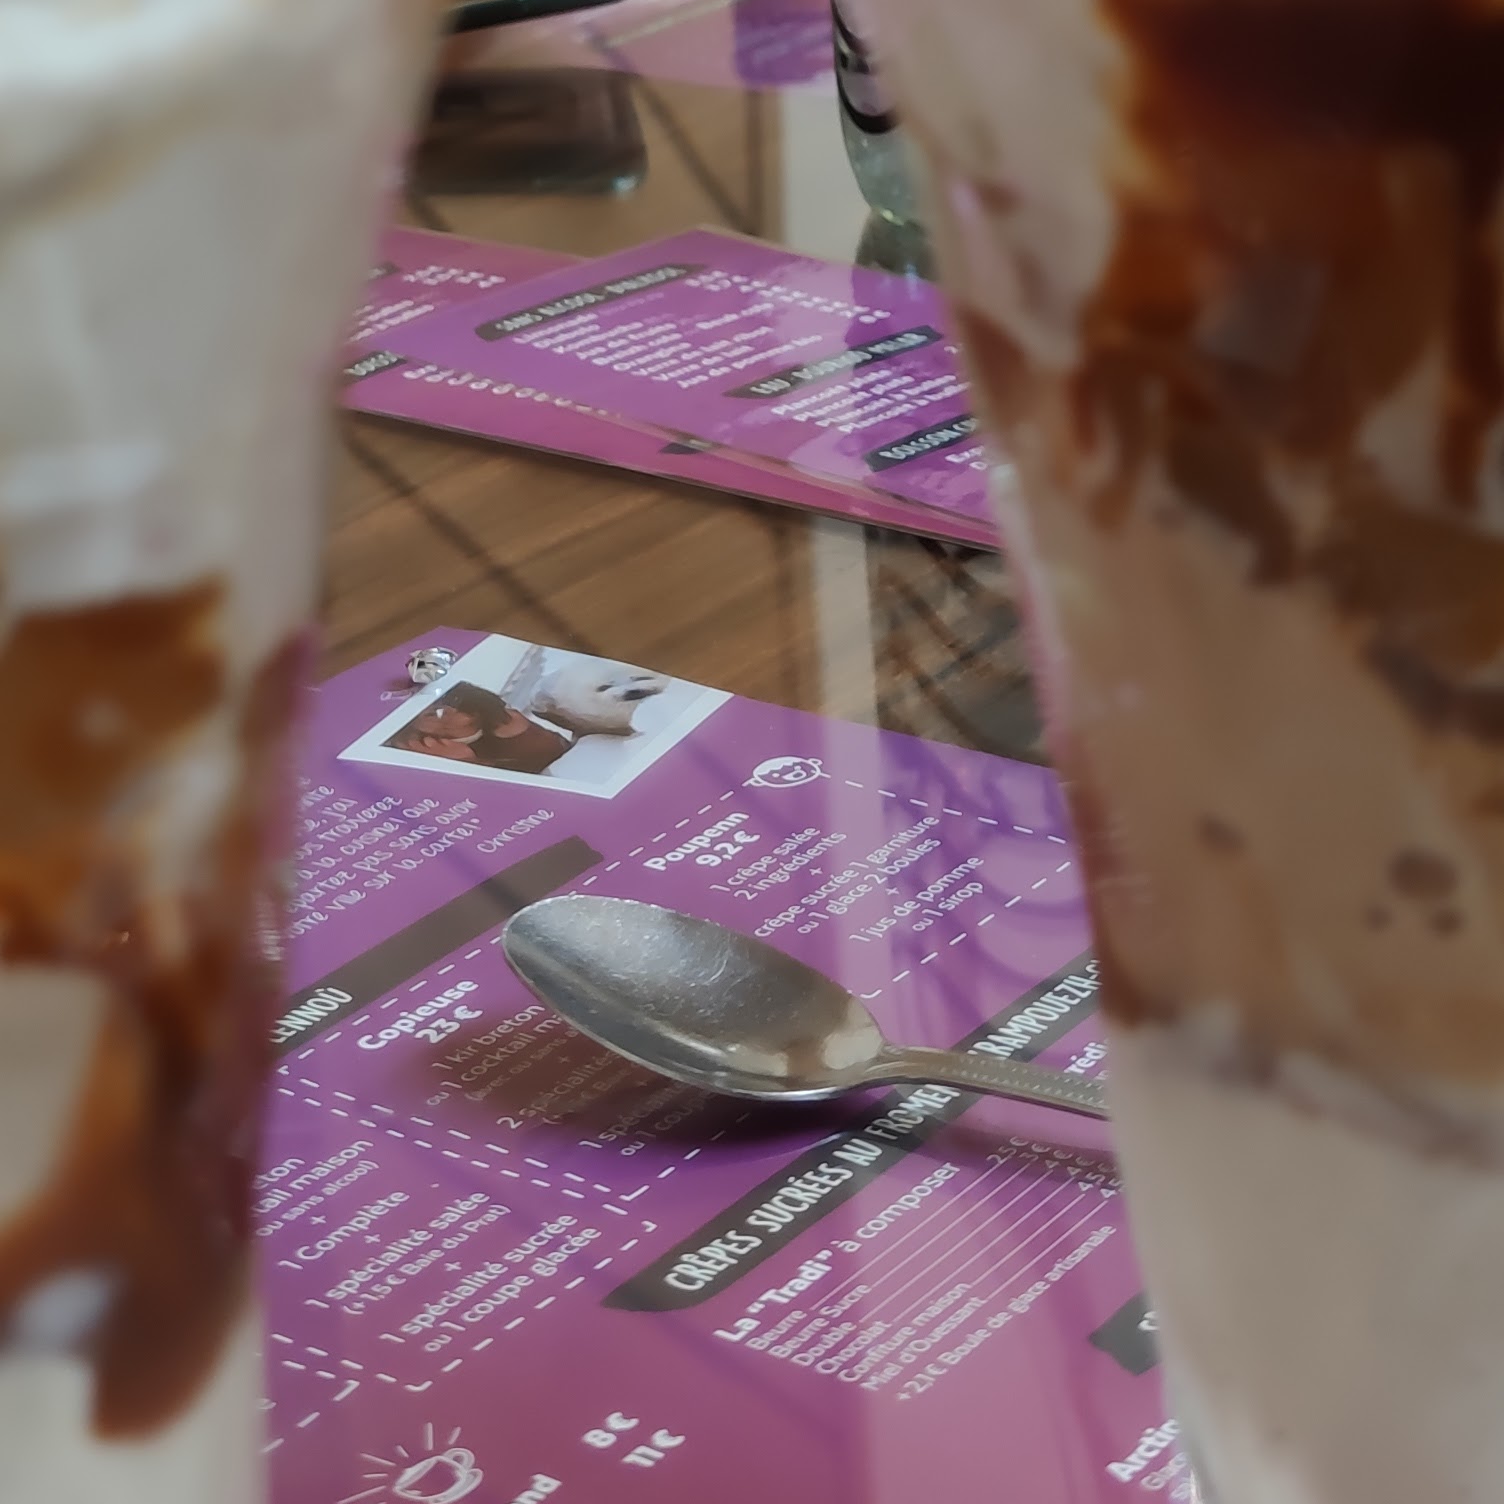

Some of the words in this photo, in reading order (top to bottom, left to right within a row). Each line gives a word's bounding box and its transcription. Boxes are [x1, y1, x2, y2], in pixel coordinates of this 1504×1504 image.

[352, 849, 394, 873] pas
[389, 824, 438, 850] sans
[476, 808, 555, 854] Christine
[643, 812, 749, 871] Poupenn
[727, 853, 777, 887] crêpe
[772, 827, 821, 855] salée
[363, 870, 397, 890] sur
[753, 831, 848, 892] ingrédients
[754, 905, 805, 938] crêpe
[801, 871, 858, 906] sucrée
[866, 815, 939, 864] garniture
[825, 883, 872, 914] glace
[885, 838, 941, 875] boules
[916, 856, 985, 901] pomme
[937, 881, 984, 911] sirop
[357, 980, 479, 1050] Copieuse
[473, 1003, 545, 1047] breton
[461, 1032, 537, 1082] cocktail
[289, 1139, 373, 1192] maison
[282, 1196, 325, 1221] sans
[297, 1191, 410, 1261] Complète
[663, 1229, 763, 1290] CRÊPES
[747, 1162, 855, 1234] SUCRÉES
[833, 1138, 883, 1167] AU
[326, 1229, 433, 1300] spécialité
[429, 1192, 490, 1230] salée
[400, 1248, 444, 1276] Baie
[400, 1261, 508, 1334] spécialité
[504, 1214, 577, 1263] sucrée
[713, 1315, 761, 1342] La
[855, 1161, 960, 1241] composer
[461, 1275, 534, 1323] coupe
[530, 1227, 601, 1277] glacée
[941, 1327, 993, 1365] Boule
[1009, 1275, 1050, 1315] glace
[1044, 1224, 1117, 1283] artisanale
[745, 1309, 807, 1351] Beurre
[768, 1317, 830, 1359] Beurre
[820, 1283, 872, 1318] Sucre
[790, 1321, 857, 1366] Double
[814, 1319, 892, 1375] Chocolat
[837, 1326, 917, 1383] Confiture
[911, 1281, 973, 1328] maison
[860, 1363, 902, 1392] Miel
[581, 1411, 639, 1449] 8€
